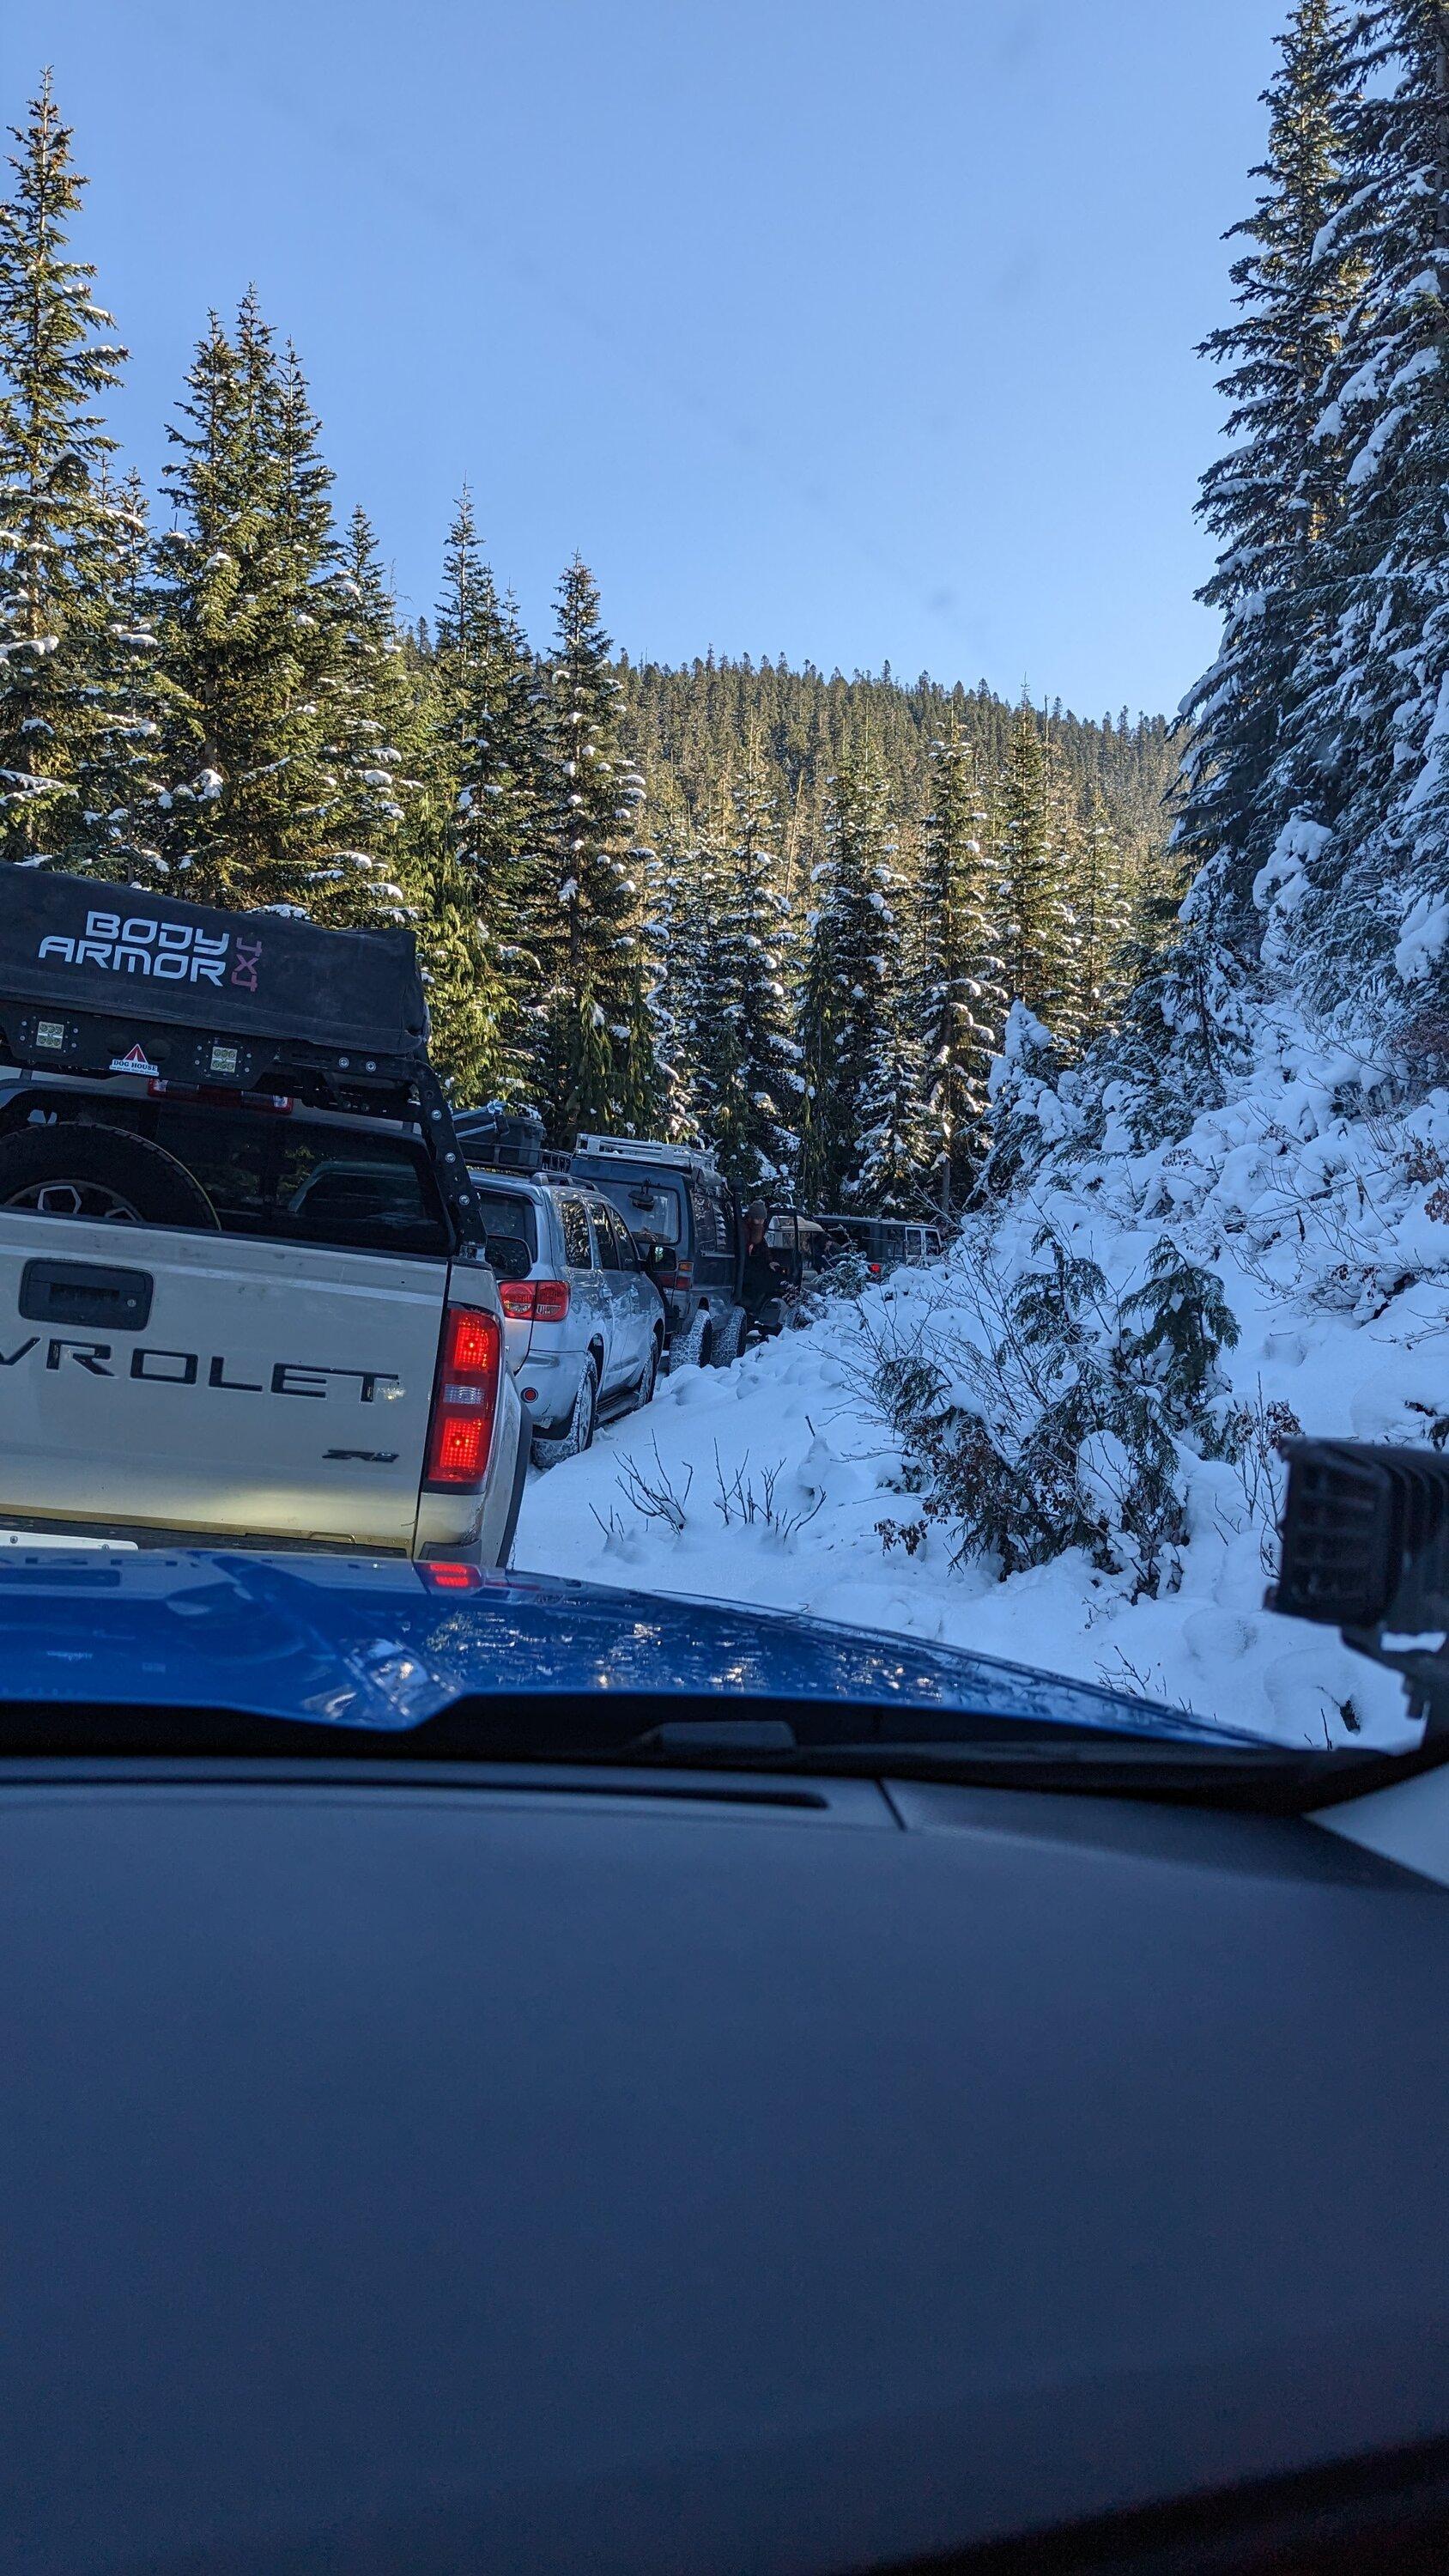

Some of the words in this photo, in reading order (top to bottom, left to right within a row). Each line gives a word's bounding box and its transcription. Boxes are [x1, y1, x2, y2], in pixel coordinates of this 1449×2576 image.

[86, 910, 229, 956] BODY
[38, 935, 226, 987] ARMOR
[131, 1062, 157, 1071] HOUSE
